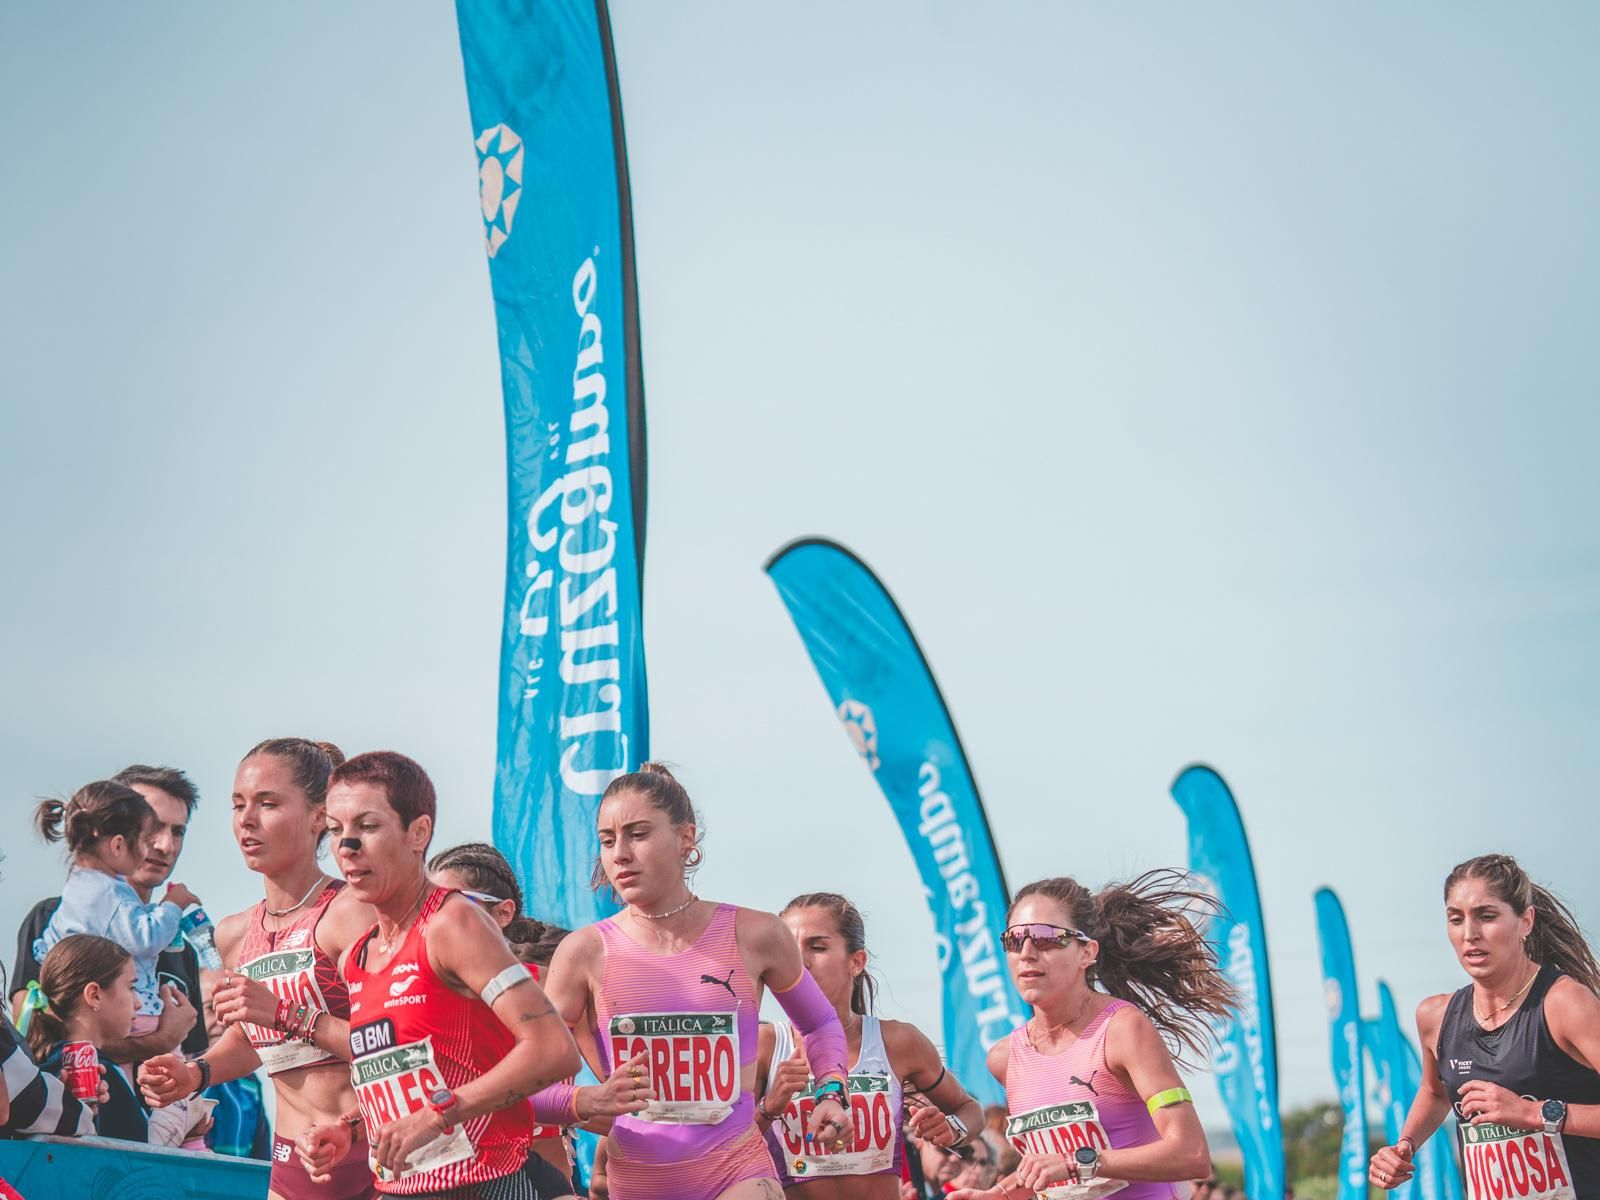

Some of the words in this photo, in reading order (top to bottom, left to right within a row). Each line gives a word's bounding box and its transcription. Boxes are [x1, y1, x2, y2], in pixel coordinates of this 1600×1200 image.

[252, 958, 288, 978] ITÁLICA
[643, 1017, 703, 1032] ITÁLICA
[365, 1022, 391, 1051] BM
[361, 1056, 400, 1079] ITÁLICA
[1026, 1110, 1068, 1128] ITÁLICA
